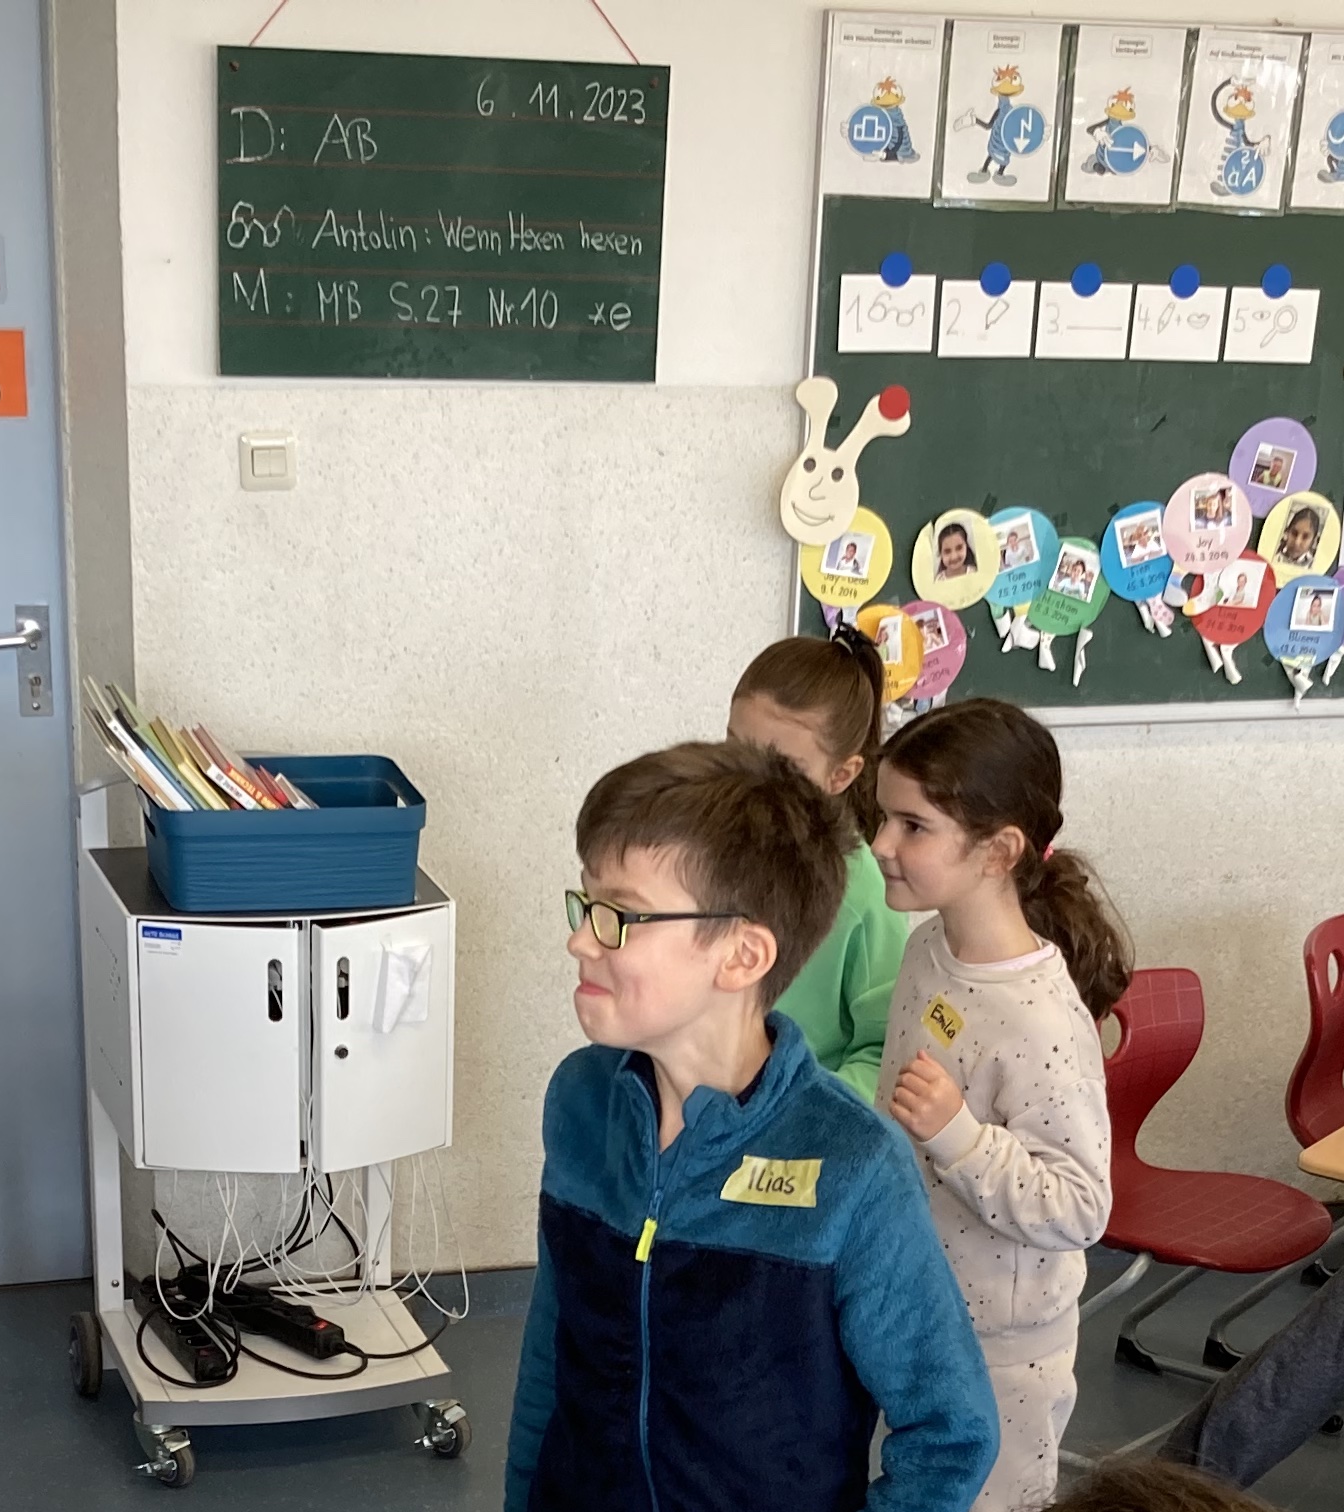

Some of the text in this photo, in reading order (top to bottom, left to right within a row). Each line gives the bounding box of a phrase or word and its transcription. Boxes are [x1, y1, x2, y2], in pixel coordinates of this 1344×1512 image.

[583, 81, 646, 125] 2023
[226, 106, 378, 165] D: AB
[312, 208, 643, 257] Antolin: Wenn Hexen hexen
[232, 267, 294, 315] M:
[317, 280, 362, 326] MB
[1006, 571, 1026, 581] Tom
[748, 1165, 795, 1195] Ilias
